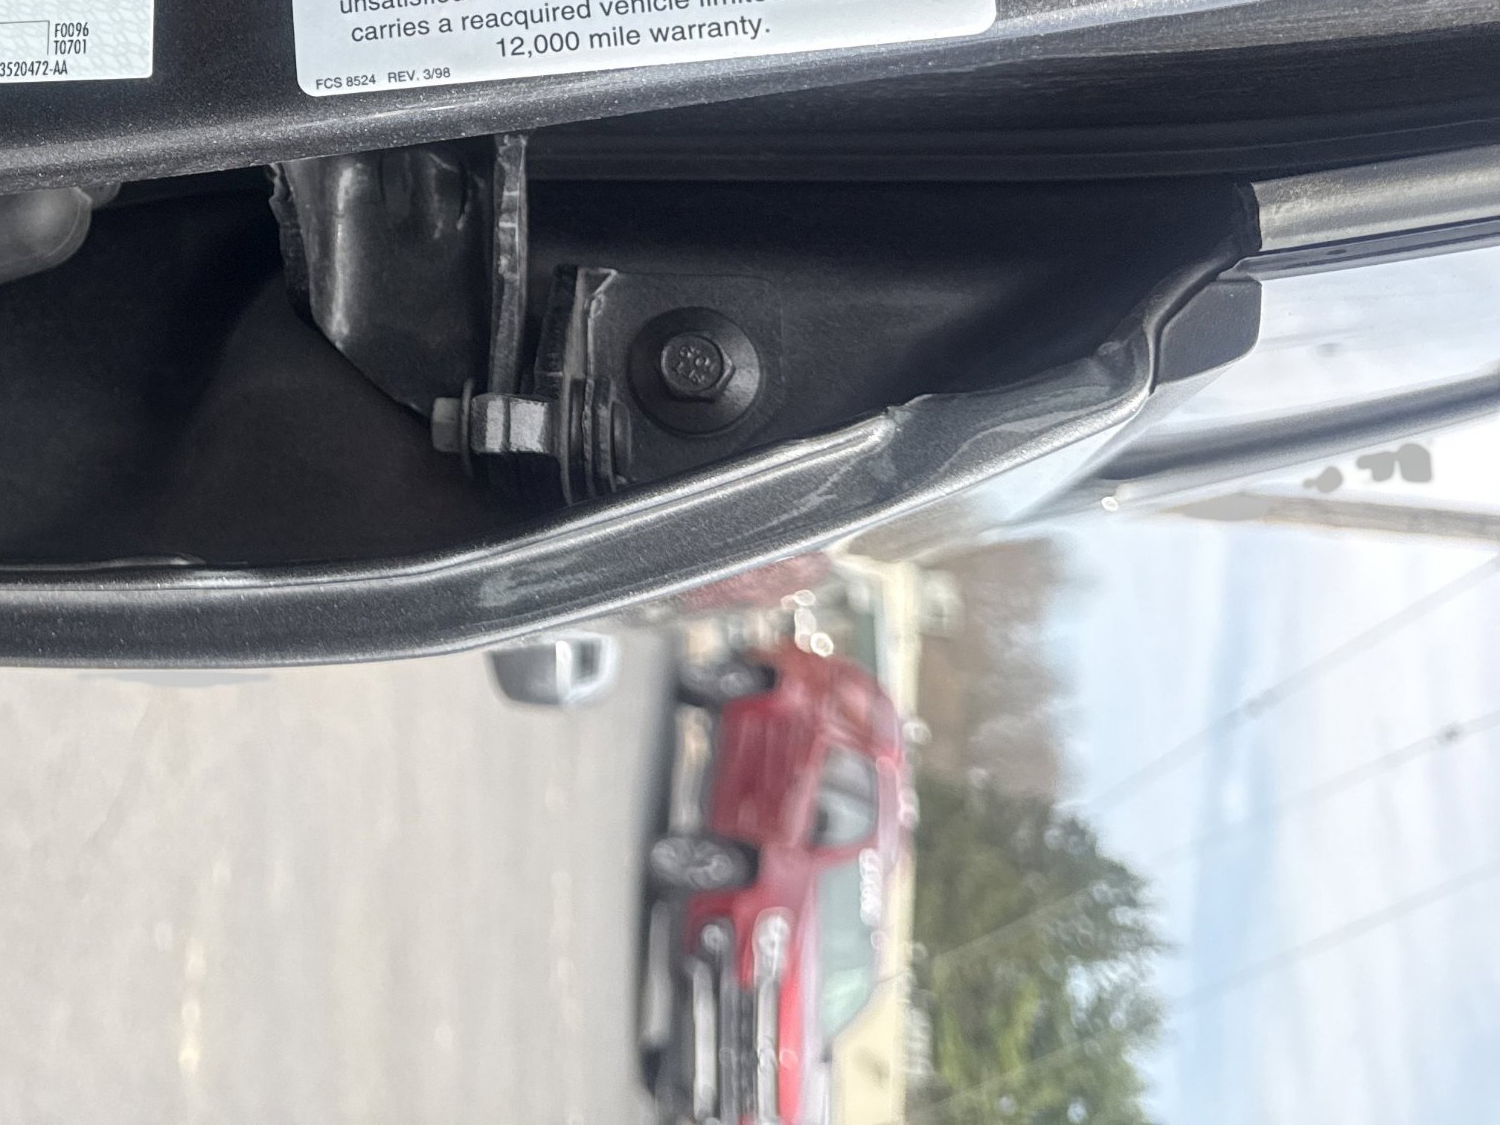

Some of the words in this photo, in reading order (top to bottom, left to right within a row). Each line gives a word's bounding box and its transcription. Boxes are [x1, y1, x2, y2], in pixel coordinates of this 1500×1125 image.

[54, 21, 89, 37] F0096
[351, 17, 429, 41] carries
[438, 17, 452, 33] a
[496, 30, 579, 58] 12,000
[589, 25, 640, 48] mile
[648, 15, 769, 42] warranty.
[53, 38, 86, 55] T0701
[315, 76, 342, 89] FCS
[345, 73, 376, 87] 8524
[387, 69, 419, 83] REV.
[422, 66, 450, 79] 3/98
